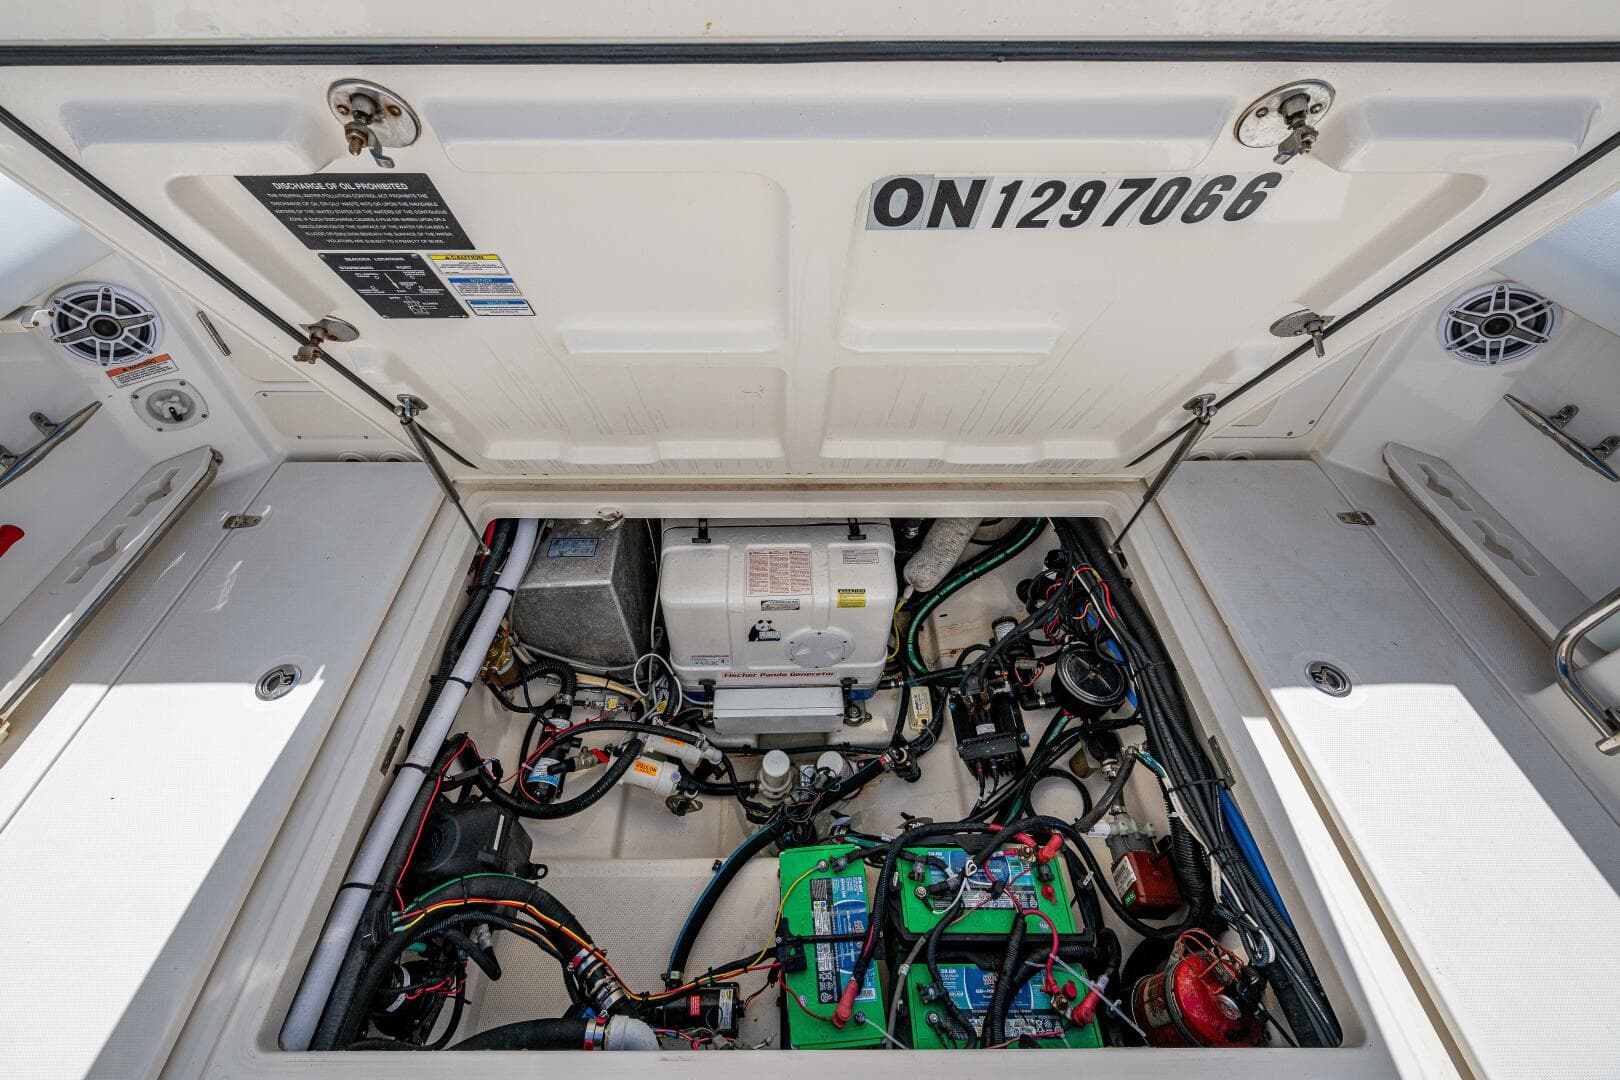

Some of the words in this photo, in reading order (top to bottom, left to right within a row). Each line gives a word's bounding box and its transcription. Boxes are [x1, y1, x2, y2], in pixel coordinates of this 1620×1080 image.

[271, 182, 326, 190] DISCHARGE
[325, 182, 338, 190] OF
[339, 182, 356, 190] OIL
[355, 182, 408, 190] PROHIBITED
[873, 177, 987, 229] ON
[991, 172, 1282, 229] 1297066
